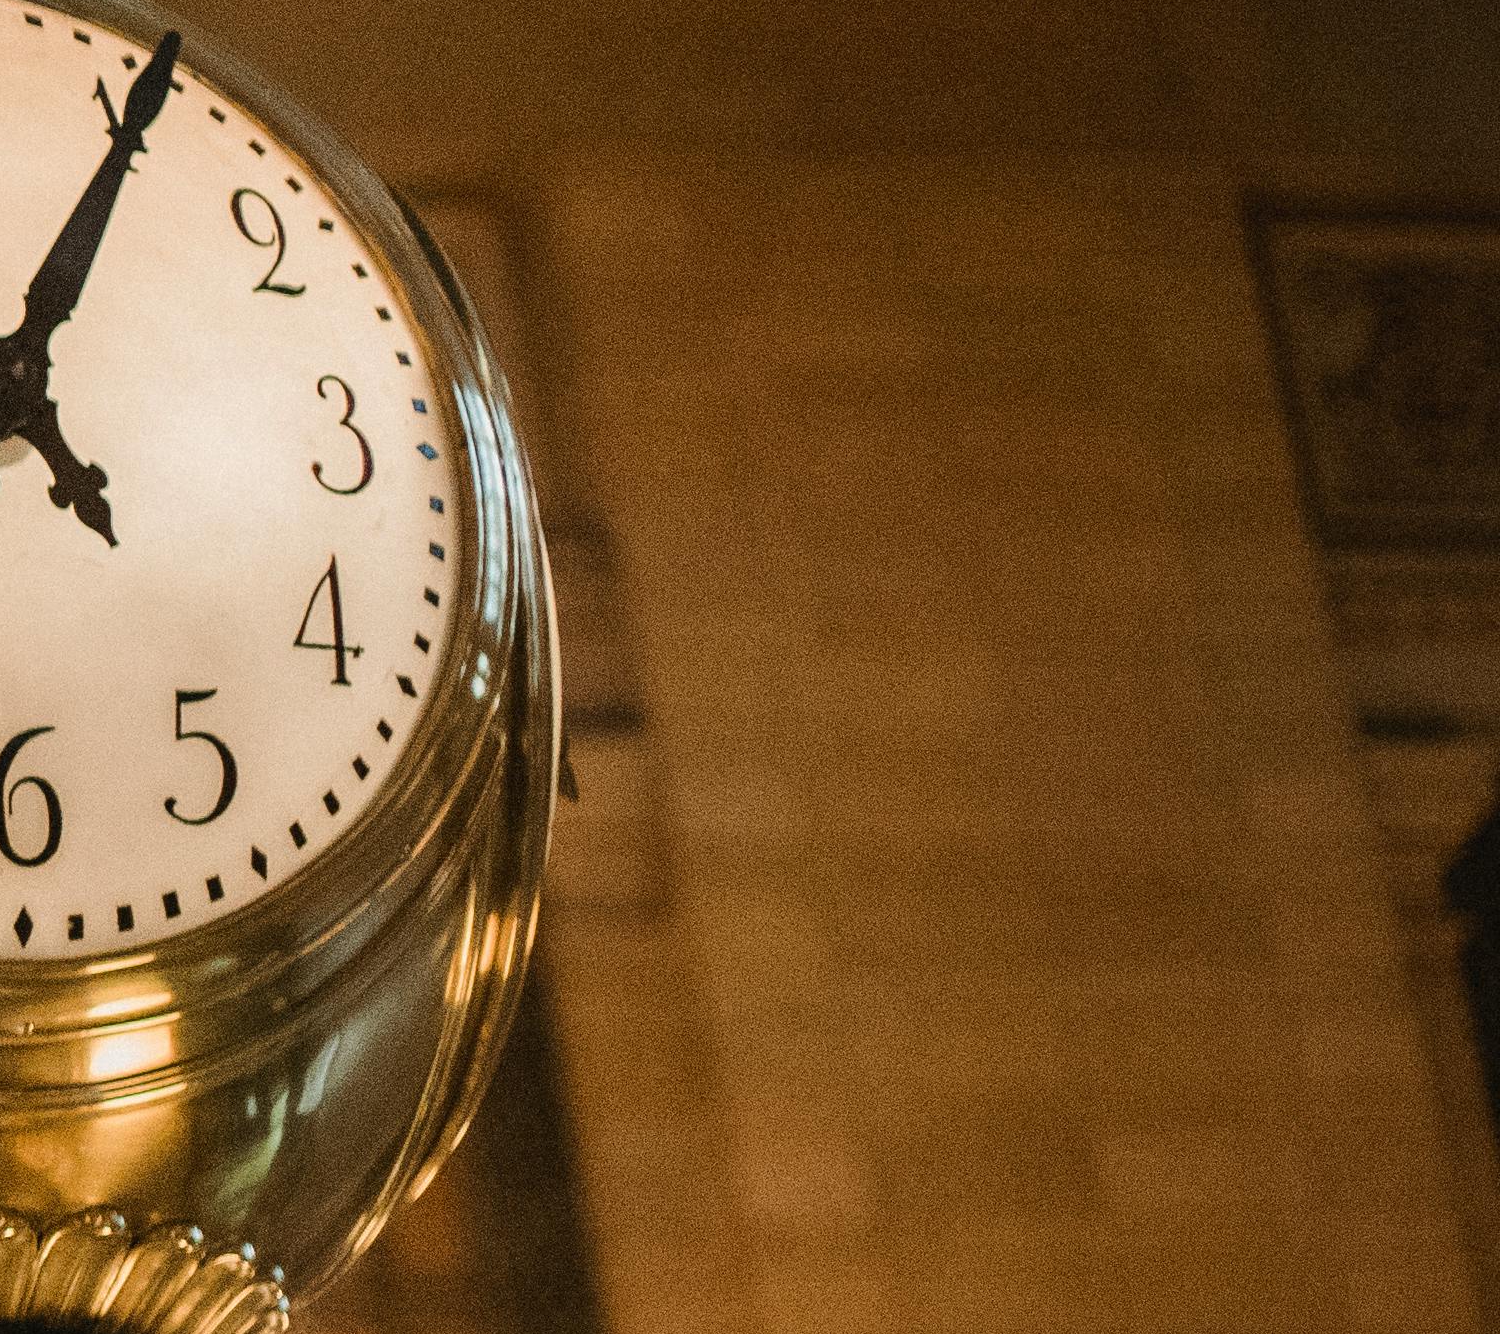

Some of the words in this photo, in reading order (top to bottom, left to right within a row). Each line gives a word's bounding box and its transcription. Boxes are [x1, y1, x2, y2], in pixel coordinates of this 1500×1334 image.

[230, 188, 306, 296] 2
[311, 374, 375, 497] 3
[292, 554, 365, 688] 4
[163, 688, 238, 827] 5
